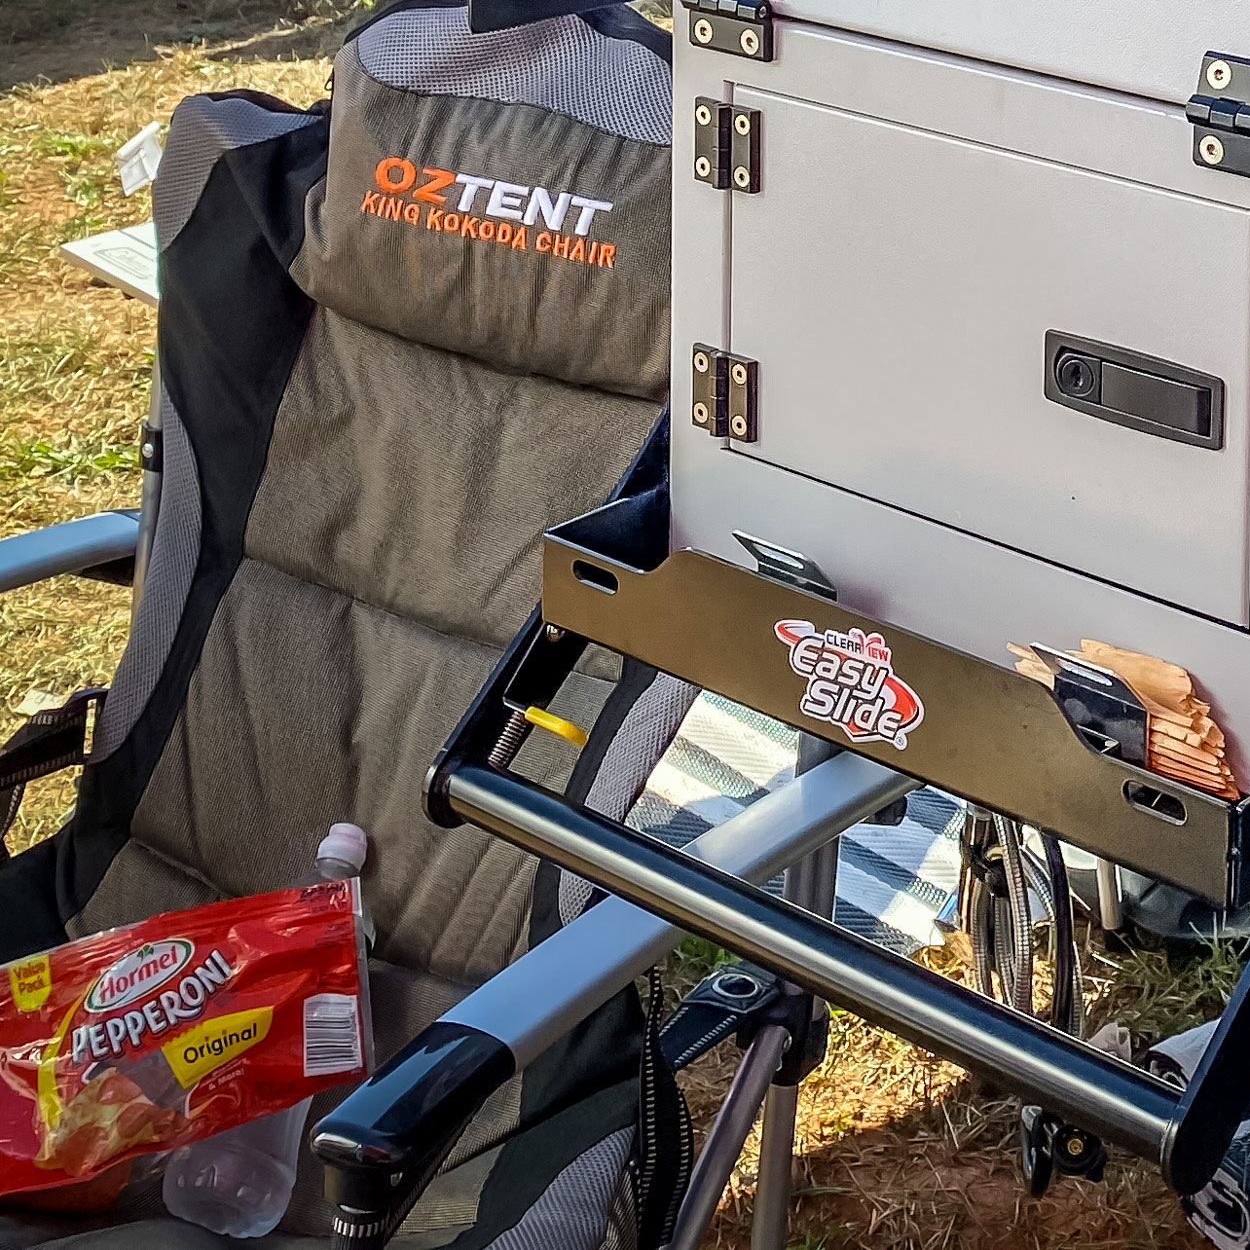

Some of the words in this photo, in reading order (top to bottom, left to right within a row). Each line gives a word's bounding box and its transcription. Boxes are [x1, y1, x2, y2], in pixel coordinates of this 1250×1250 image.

[374, 155, 614, 237] OZTENT
[360, 190, 420, 226] KING
[426, 207, 528, 251] KOKODA
[535, 231, 618, 270] CHAIR
[792, 635, 890, 701] Easy
[803, 678, 904, 740] Slide
[71, 949, 235, 1065] PEPPERONI
[98, 944, 179, 1004] Hormel
[183, 1022, 258, 1065] Original
